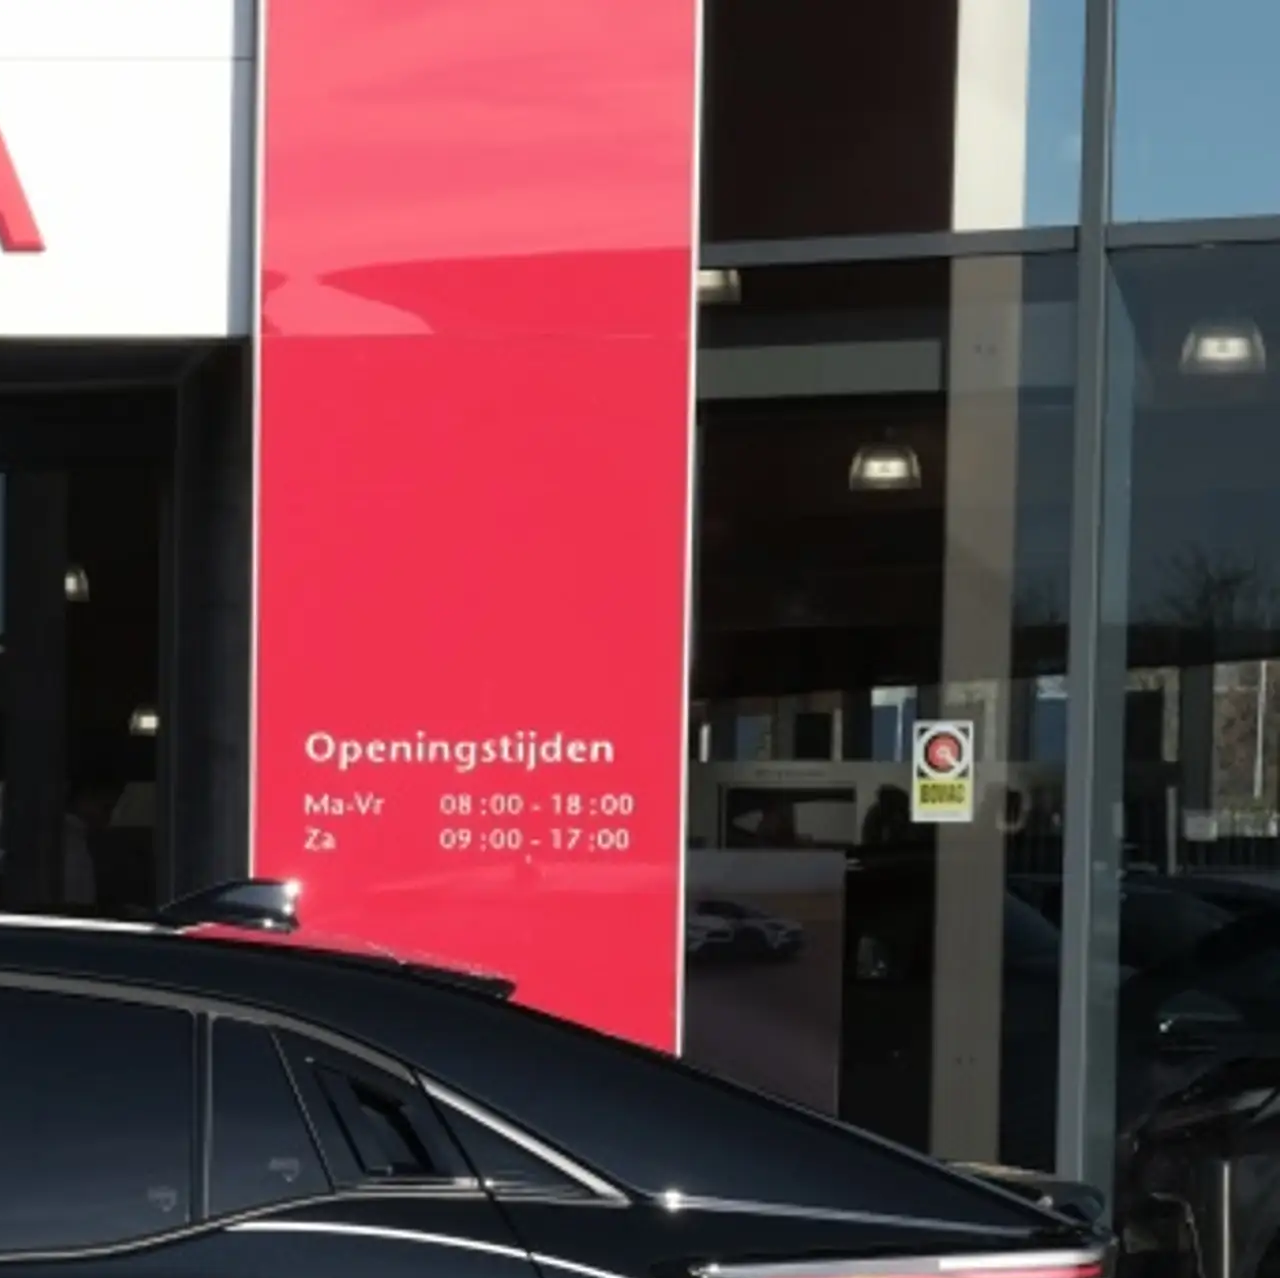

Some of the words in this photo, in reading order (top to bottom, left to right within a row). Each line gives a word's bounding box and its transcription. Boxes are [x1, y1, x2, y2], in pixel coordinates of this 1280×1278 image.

[304, 729, 615, 773] Openingstijden
[303, 793, 384, 815] Ma-Vr
[303, 827, 336, 850] Za
